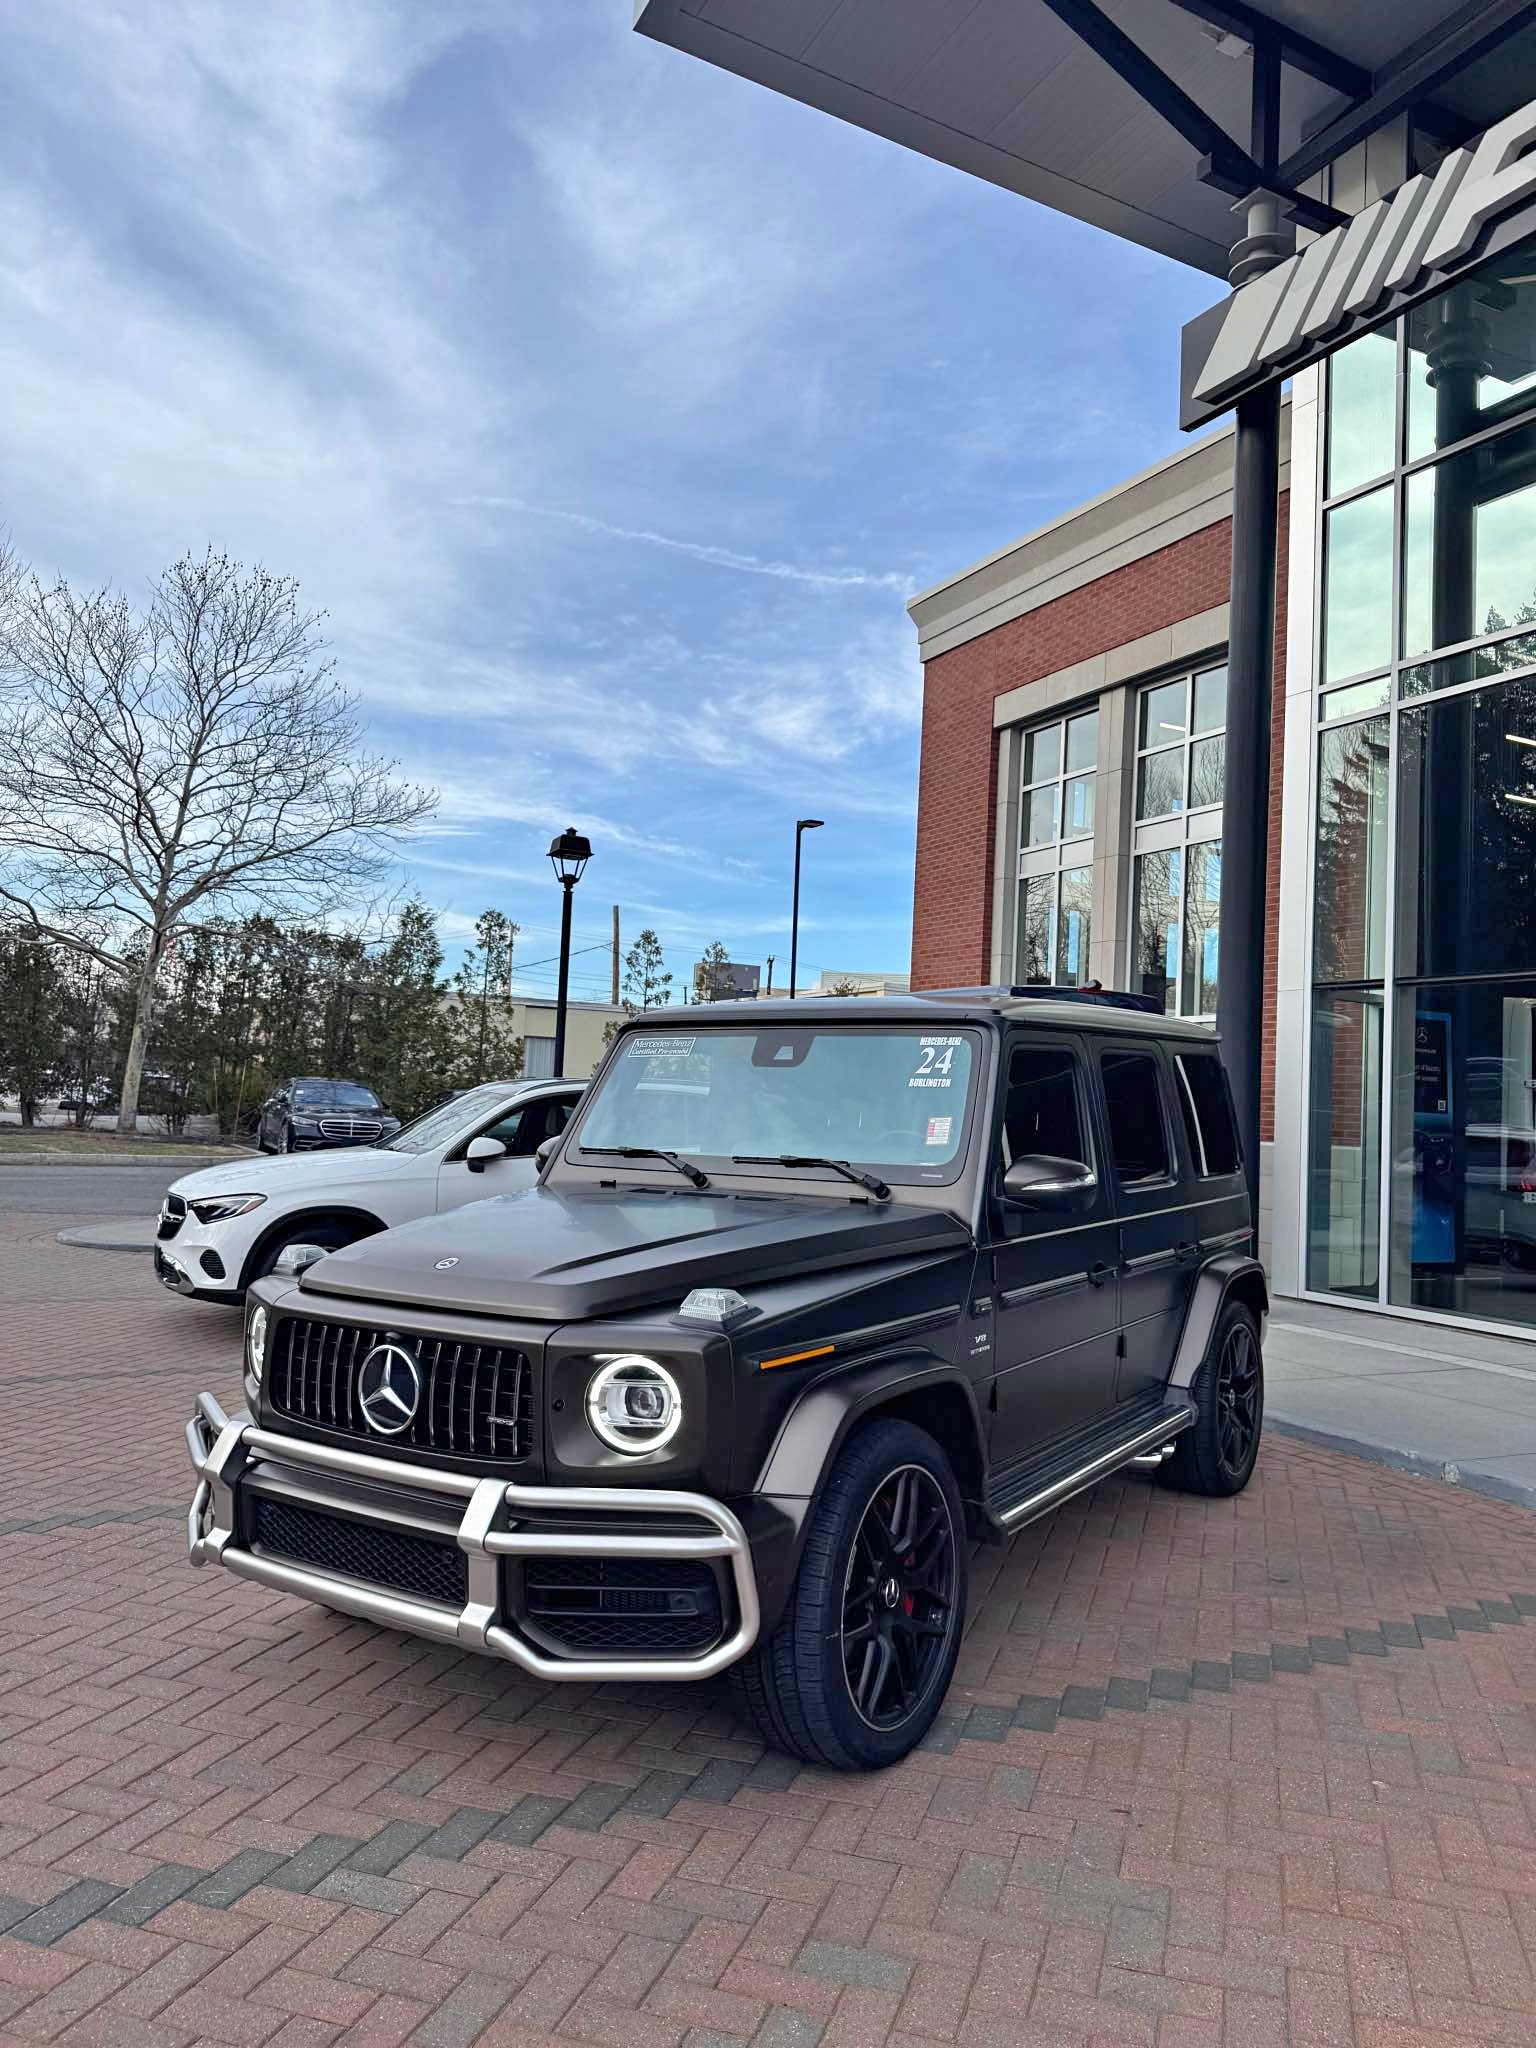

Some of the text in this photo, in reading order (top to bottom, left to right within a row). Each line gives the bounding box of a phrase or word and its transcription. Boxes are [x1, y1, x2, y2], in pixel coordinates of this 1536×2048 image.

[634, 1040, 692, 1048] Mercedes-Benz
[919, 1036, 962, 1045] MERCEDES-BENZ
[915, 1046, 954, 1074] 24
[909, 1078, 952, 1087] BURLINGTON
[974, 1334, 987, 1343] V8
